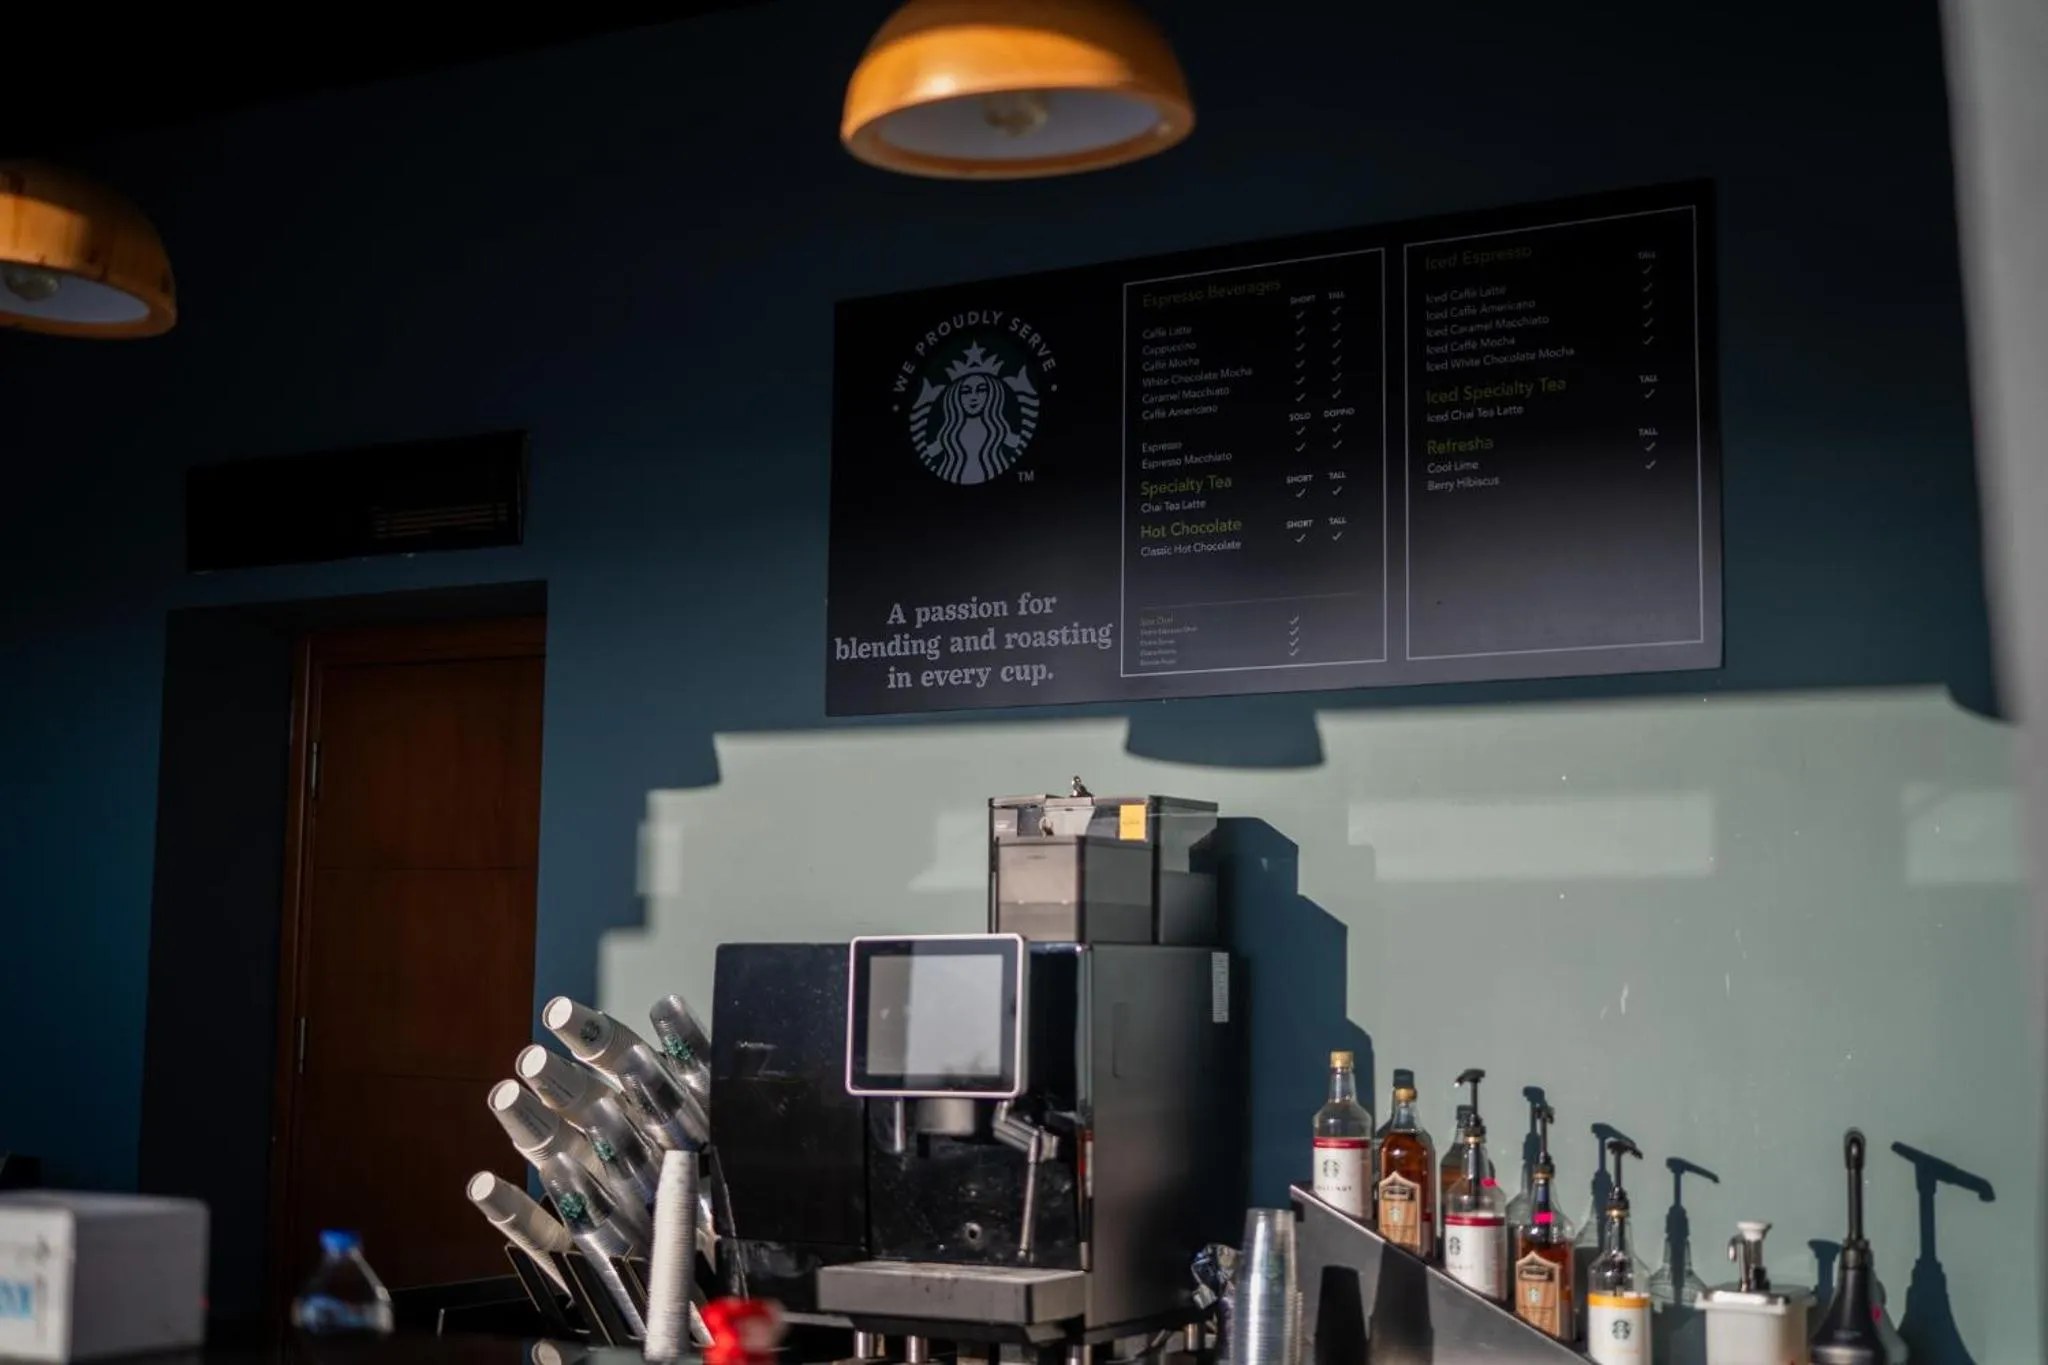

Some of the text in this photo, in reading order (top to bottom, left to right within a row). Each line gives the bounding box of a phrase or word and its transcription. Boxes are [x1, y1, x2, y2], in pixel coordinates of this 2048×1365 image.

[1425, 245, 1533, 271] Iced Espresso
[1142, 279, 1282, 309] Espresso Beverages
[1425, 292, 1448, 304] Iced
[1479, 284, 1508, 298] Latte
[1425, 309, 1448, 322] Iced
[1479, 299, 1536, 316] Americano
[1168, 325, 1192, 338] Latte
[1425, 314, 1550, 339] Iced Caramel Macchiato
[893, 310, 1057, 393] WE PROUDLY SERVE
[1142, 341, 1197, 357] Cappuccino
[1425, 343, 1449, 355] Iced
[1479, 335, 1516, 348] Mocha
[1168, 357, 1200, 370] Mocha
[1425, 345, 1576, 373] Iced White Chocolate Mocha
[1142, 367, 1253, 390] White Chocolate Mocha
[1638, 374, 1660, 384] TALL
[1142, 386, 1230, 405] Caramel Macchiato
[1425, 376, 1567, 406] Iced Specialty Tea
[1168, 405, 1218, 418] Americano
[1288, 412, 1311, 422] SOLO
[1426, 404, 1525, 423] Iced Chai Tea Latte
[1638, 427, 1659, 437] TALL
[1142, 440, 1183, 454] Espresso
[1426, 435, 1495, 456] Refresha
[1141, 452, 1232, 471] Espresso Macchiato
[1427, 459, 1479, 474] Cool Lime
[1140, 475, 1232, 499] Specialty Tea
[1286, 471, 1347, 485] SHORT TALL
[1427, 475, 1500, 493] Berry Hibiscus
[1140, 499, 1207, 514] Chai Tea Latte
[1140, 518, 1242, 539] Hot Chocolate
[1286, 517, 1347, 530] SHORT TALL
[1140, 540, 1242, 557] Classic Hot Chocolate
[887, 592, 1058, 629] A passion for
[834, 622, 1114, 661] blending and roasting
[886, 663, 1054, 689] in every cup.
